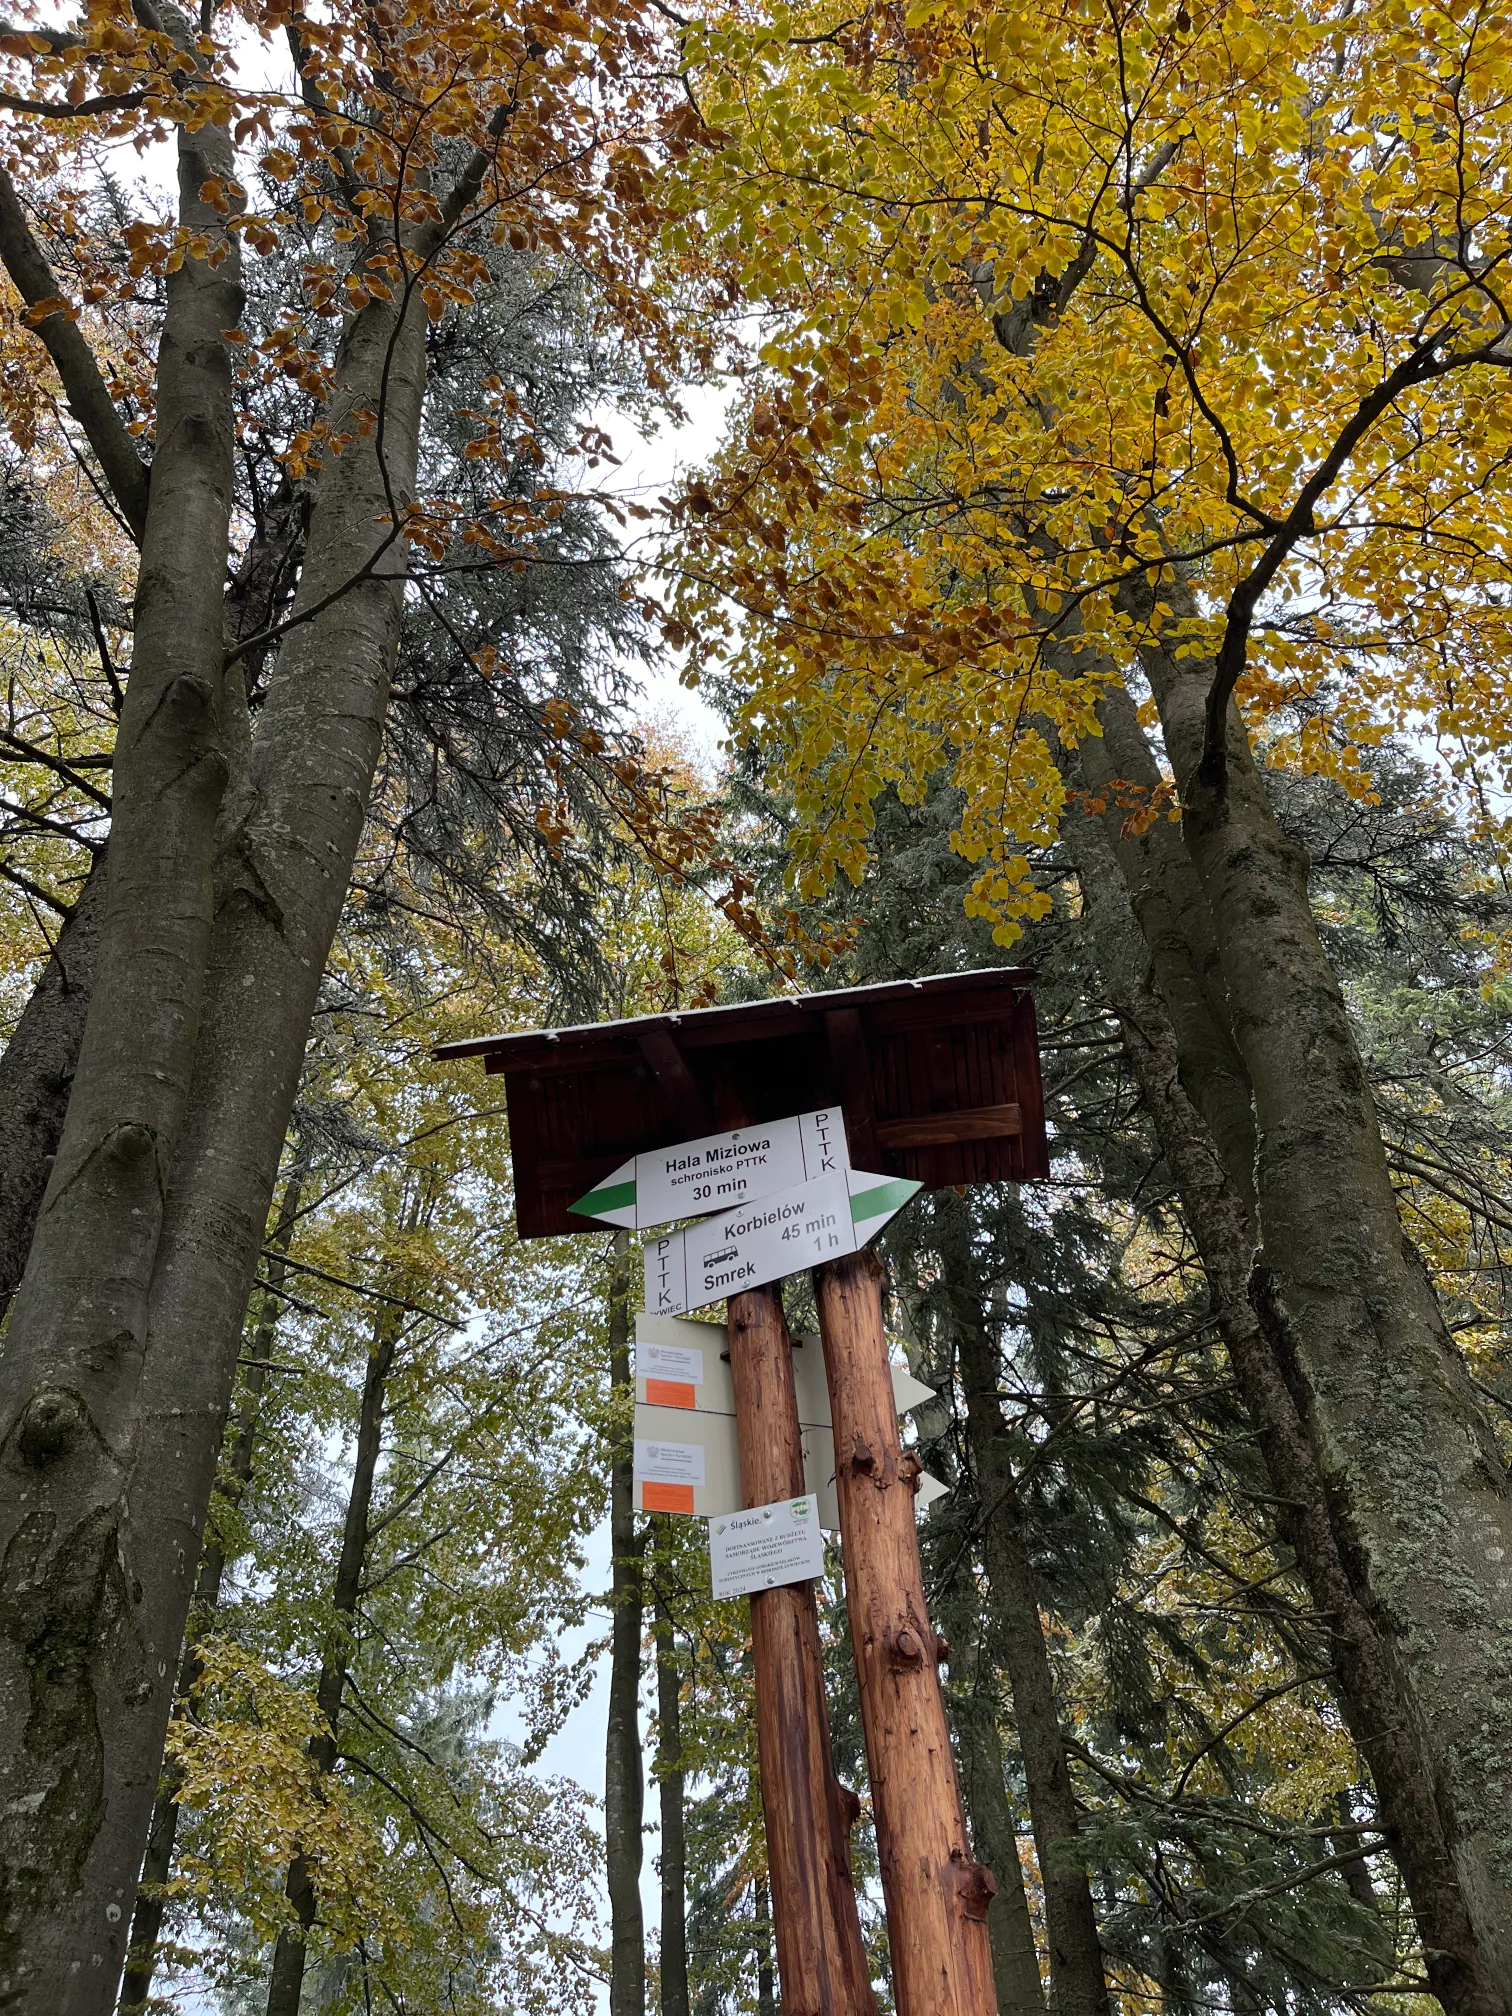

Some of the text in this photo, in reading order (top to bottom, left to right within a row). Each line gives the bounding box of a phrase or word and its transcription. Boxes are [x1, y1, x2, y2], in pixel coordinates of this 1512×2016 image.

[815, 1113, 836, 1172] PTTK
[666, 1139, 771, 1174] Hala Miziowa
[670, 1154, 768, 1186] schronisko PTTK
[693, 1178, 747, 1201] 30 min
[724, 1202, 806, 1240] Korbielów
[781, 1214, 836, 1241] 45 min
[813, 1233, 839, 1251] 1 h
[657, 1239, 672, 1307] PTTK
[704, 1262, 756, 1291] Smrek
[725, 1536, 773, 1552] DOFINANSOWANE
[779, 1529, 806, 1540] BUDŻETU
[725, 1536, 807, 1559] SAMORZĄDU WOJEWÓDZTWA
[750, 1548, 783, 1560] ŚLĄSKIEGO
[732, 1586, 746, 1594] 2024
